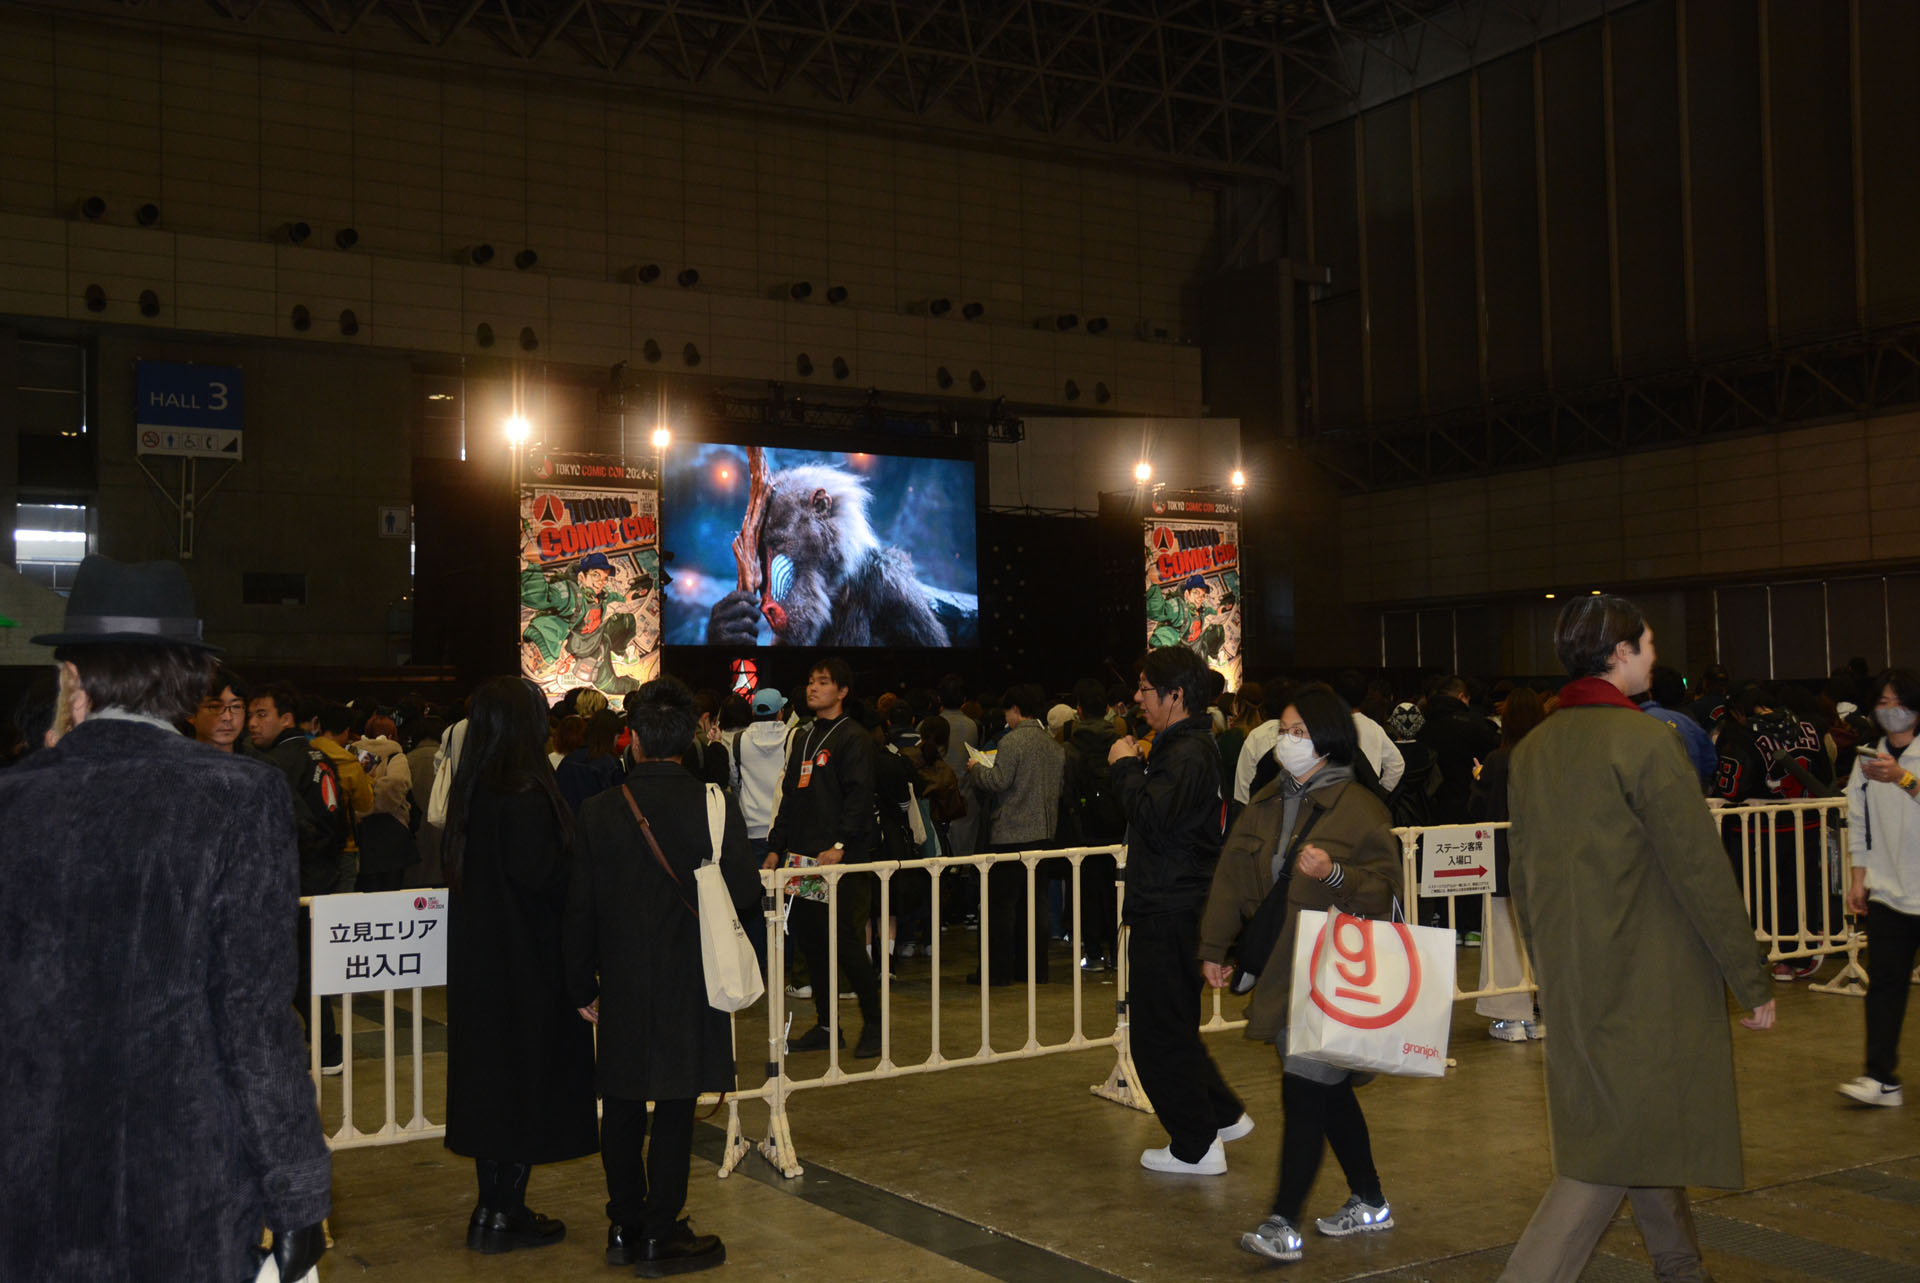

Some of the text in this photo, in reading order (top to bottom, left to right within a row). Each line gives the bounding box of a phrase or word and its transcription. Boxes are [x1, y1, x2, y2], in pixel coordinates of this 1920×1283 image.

[150, 381, 229, 411] HALL 3
[555, 463, 581, 476] TOKYO
[582, 465, 607, 477] COMIC
[608, 466, 625, 478] CON
[565, 497, 632, 525] TOKYO
[538, 513, 656, 561] COMIC CON
[1176, 528, 1220, 553] TOKYO
[1157, 543, 1237, 581] COMIC CON
[1435, 841, 1483, 854] ステージ客席
[1448, 855, 1472, 866] 入場口
[329, 919, 438, 943] 立見エリア
[345, 953, 421, 980] 出入口
[1402, 1042, 1440, 1060] graniph
